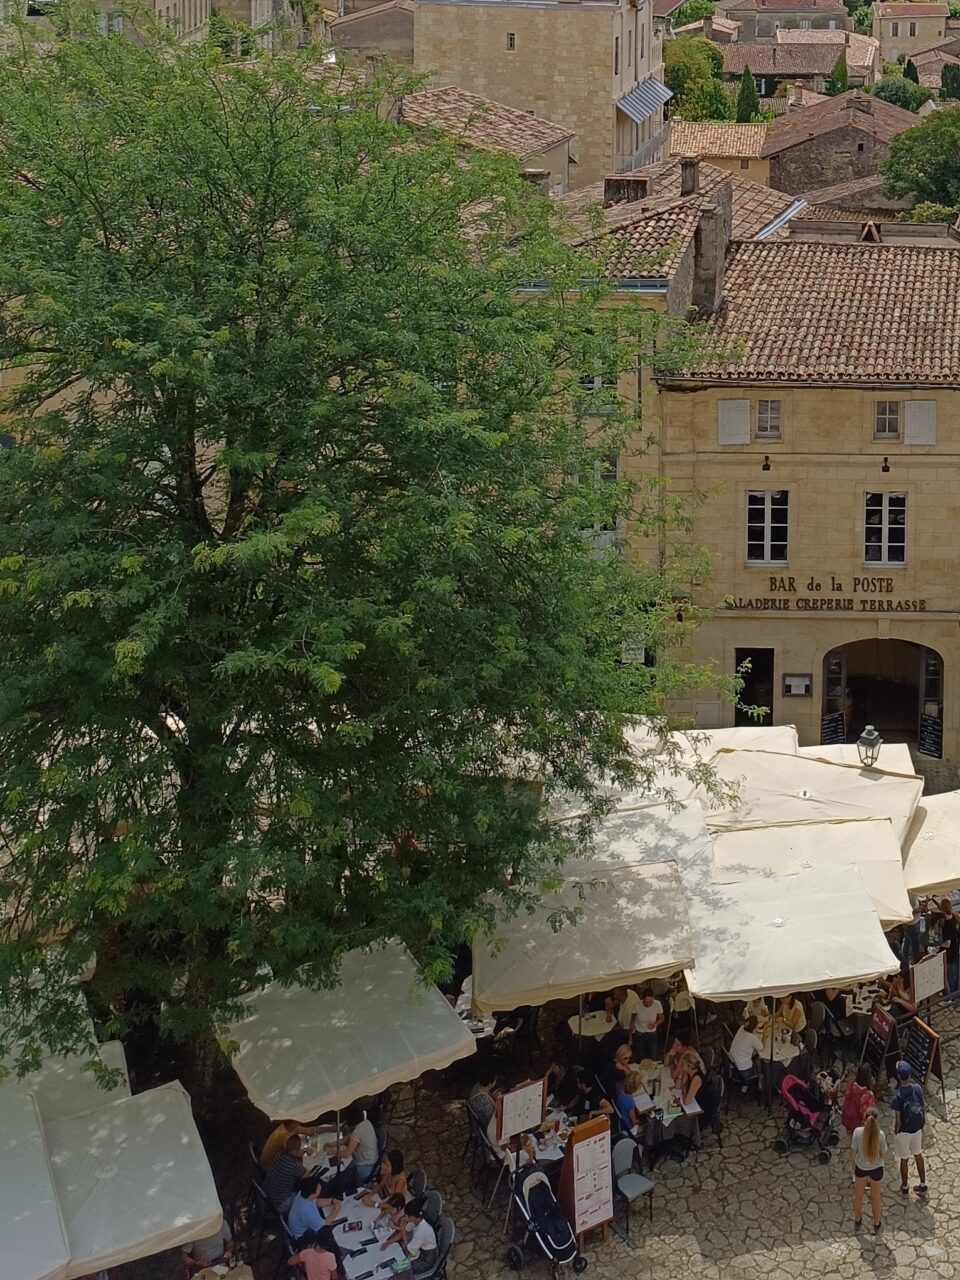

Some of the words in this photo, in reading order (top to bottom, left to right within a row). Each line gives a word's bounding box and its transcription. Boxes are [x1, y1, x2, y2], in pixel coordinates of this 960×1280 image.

[769, 576, 796, 592] BAR
[807, 577, 821, 592] de
[831, 576, 843, 592] la
[853, 577, 893, 593] POSTE
[796, 598, 854, 610] CREPERIE
[860, 599, 926, 612] TERRASSE
